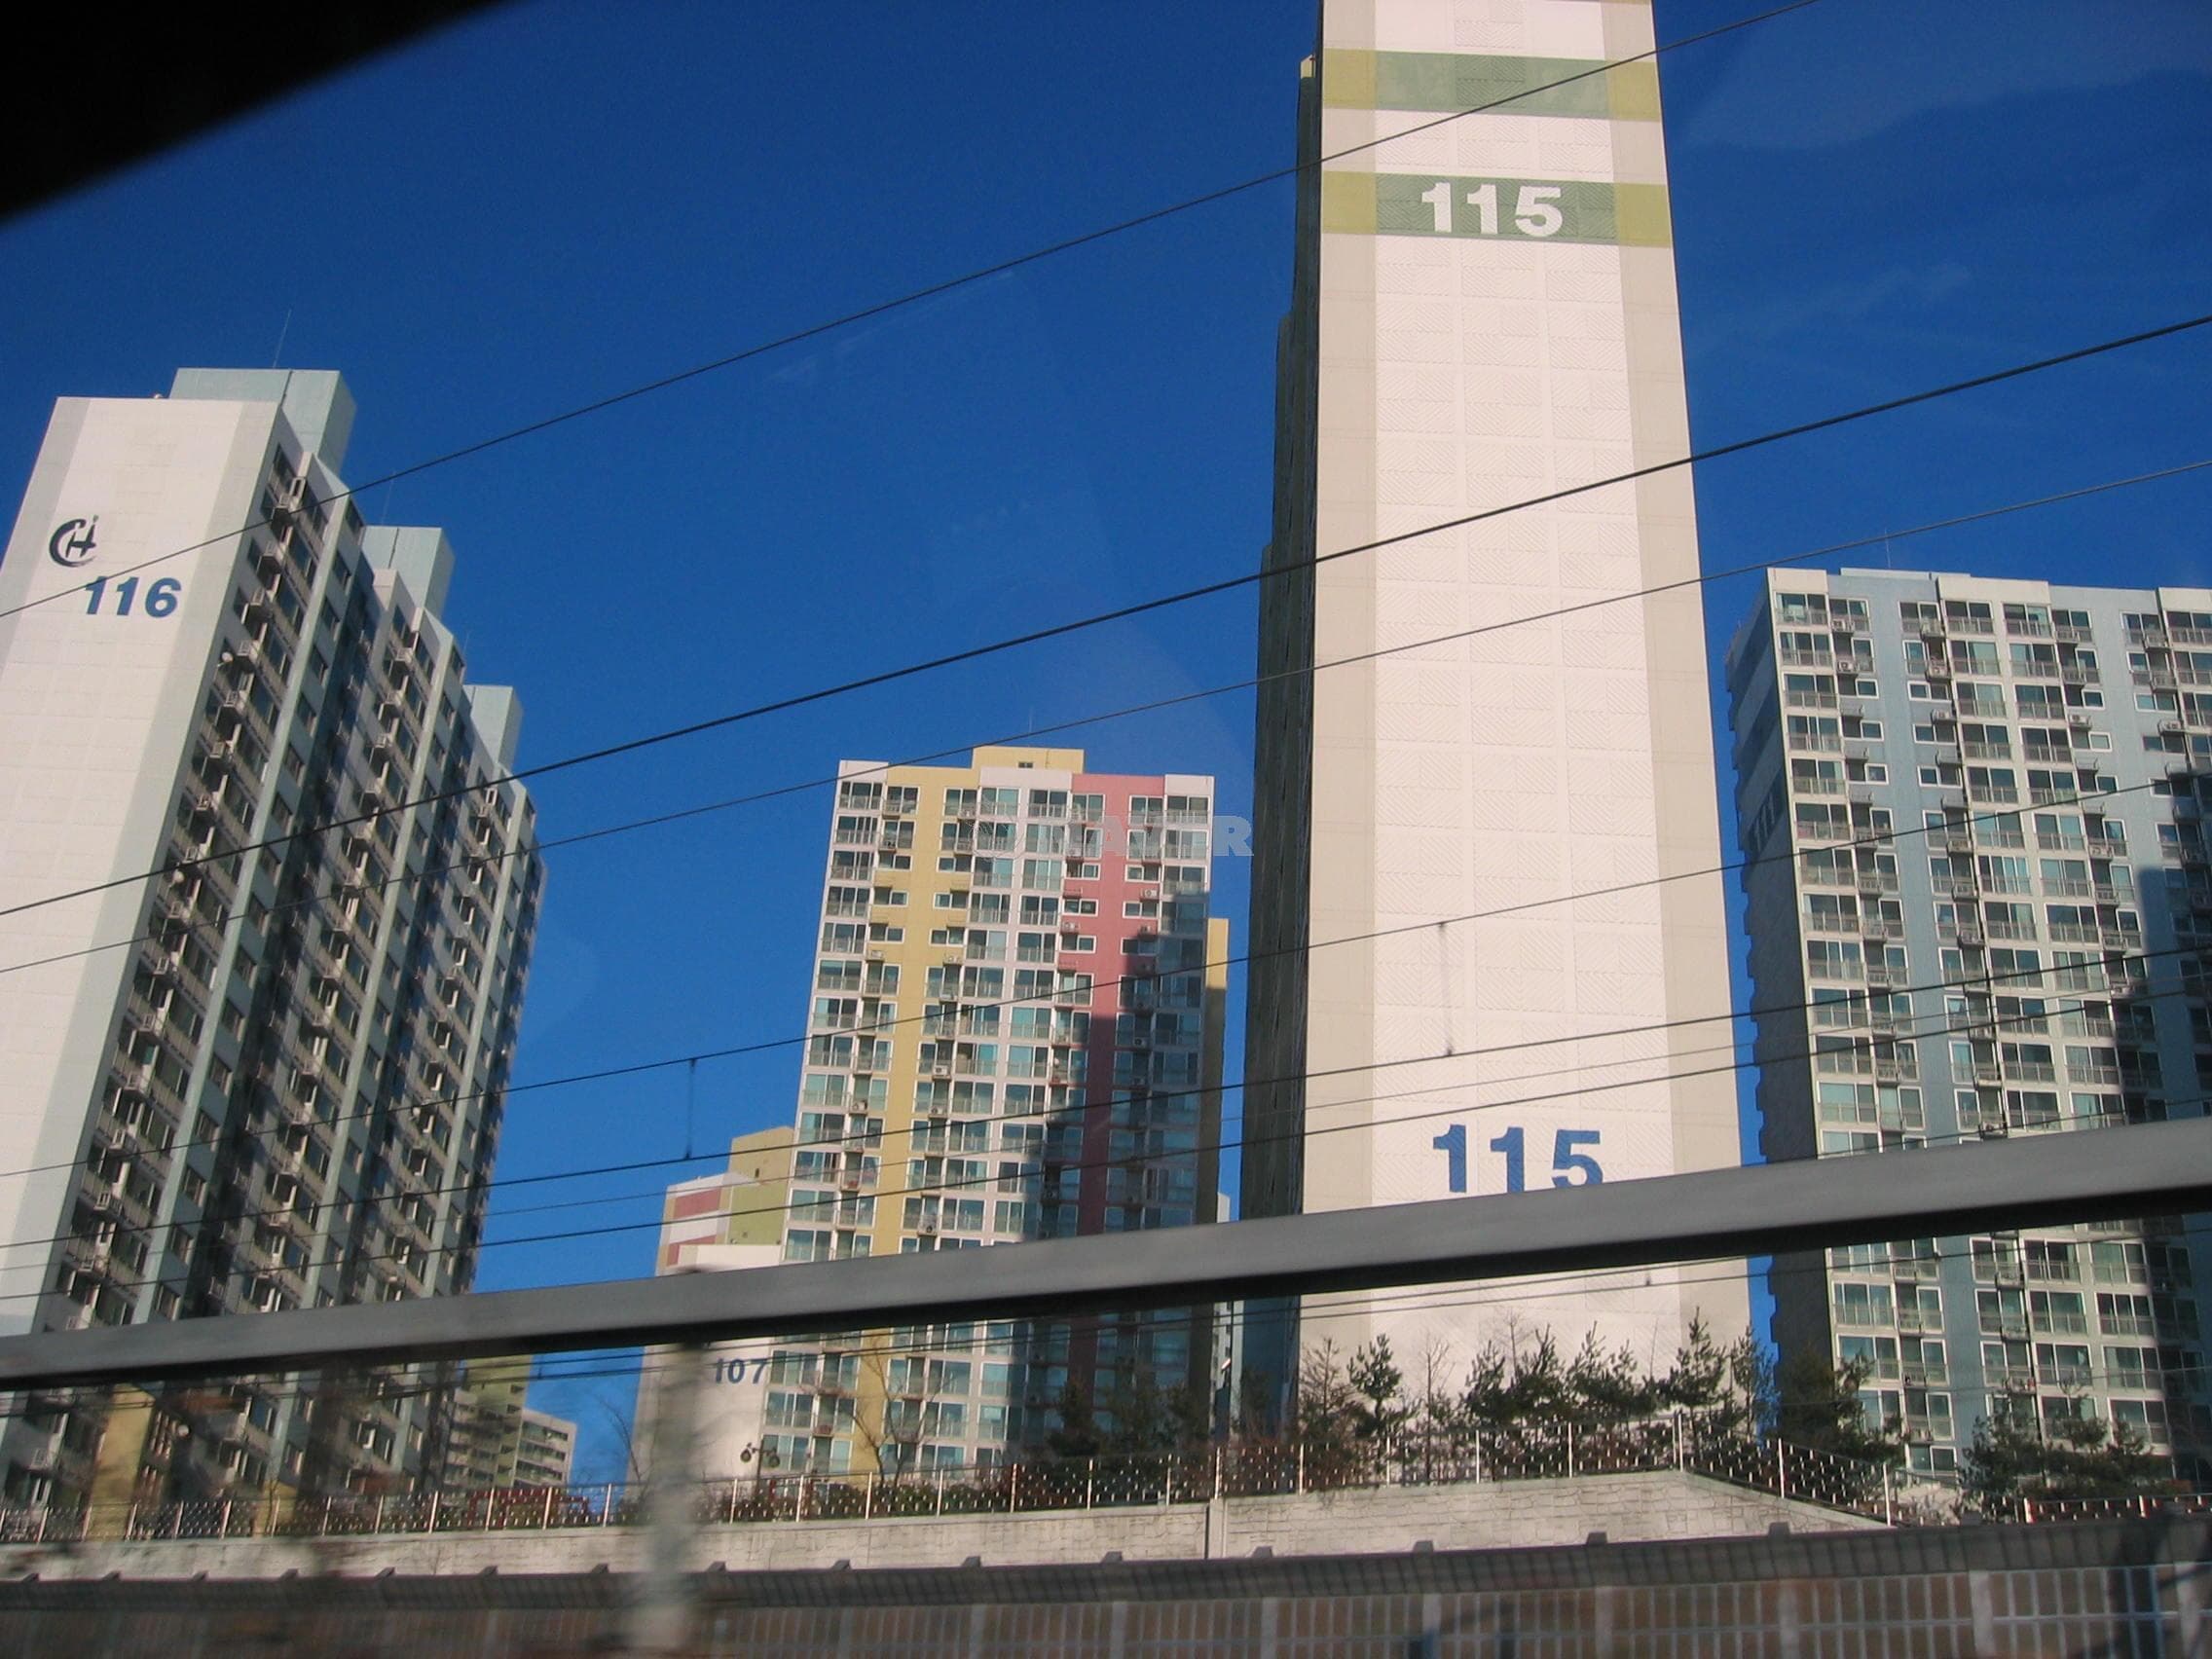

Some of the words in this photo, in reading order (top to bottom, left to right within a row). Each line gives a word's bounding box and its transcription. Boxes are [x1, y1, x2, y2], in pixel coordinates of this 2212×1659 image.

[1421, 182, 1563, 237] 115
[85, 575, 182, 618] 116
[1433, 1124, 1604, 1194] 115
[715, 1358, 770, 1384] 107
